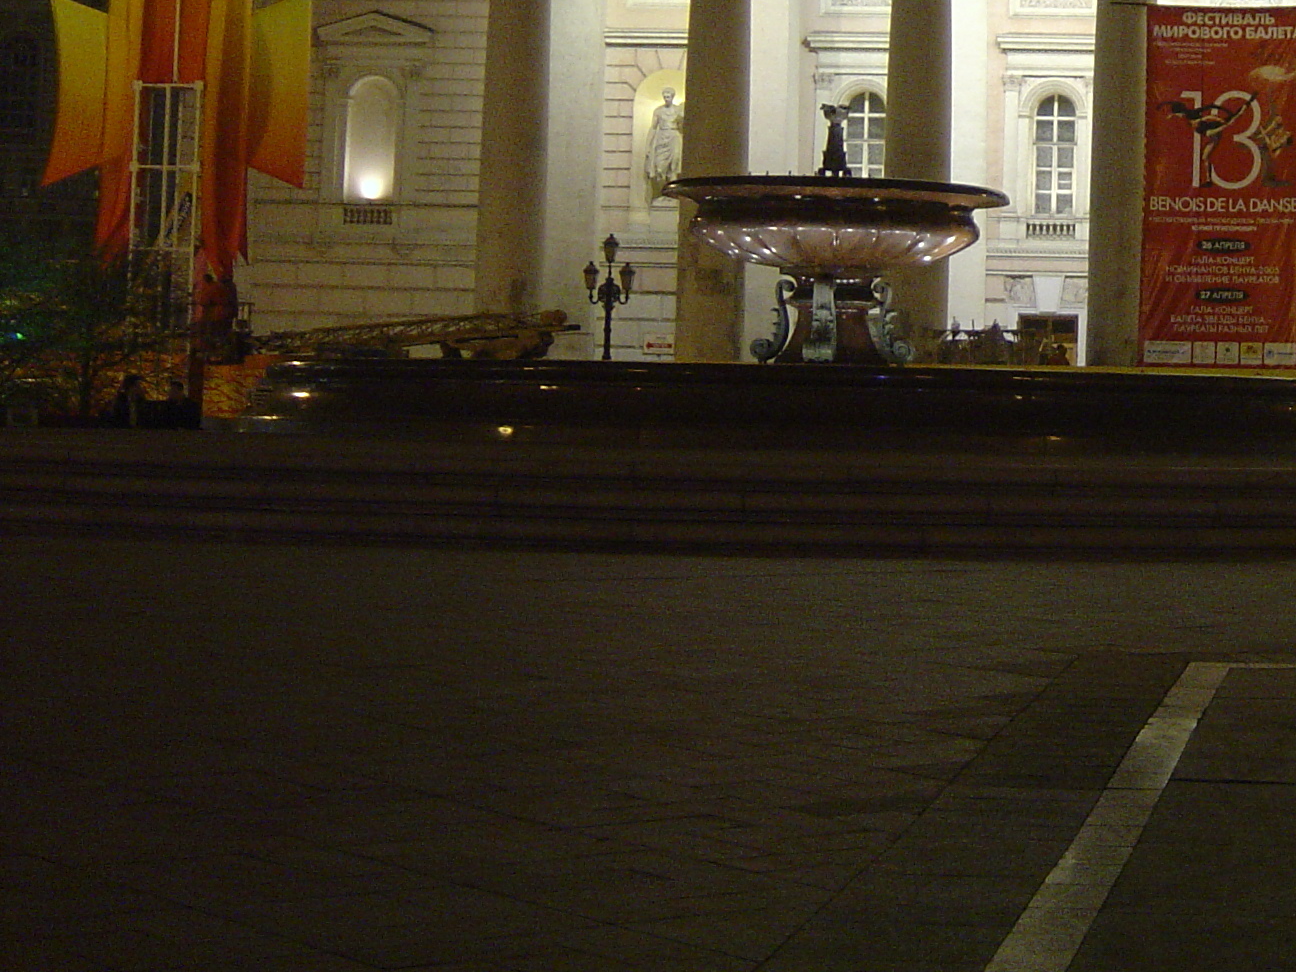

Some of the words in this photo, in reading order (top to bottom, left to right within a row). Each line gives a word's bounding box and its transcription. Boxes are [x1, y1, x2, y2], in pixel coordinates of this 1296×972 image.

[1182, 11, 1275, 26] ФЕСТИВАЛЬ
[1153, 25, 1242, 39] МИРОВОГО
[1180, 90, 1262, 189] 13
[1149, 196, 1205, 212] BENOIS
[1206, 197, 1227, 212] DE
[1229, 198, 1247, 212] LA
[1202, 241, 1212, 250] 26
[1214, 241, 1245, 250] АПРЕЛЯ
[1166, 265, 1229, 274] НОМИНАНТОВ
[1232, 275, 1280, 284] ЛАУРЕАТОВ
[1200, 291, 1211, 299] 27
[1212, 291, 1244, 299] АПРЕЛЯ
